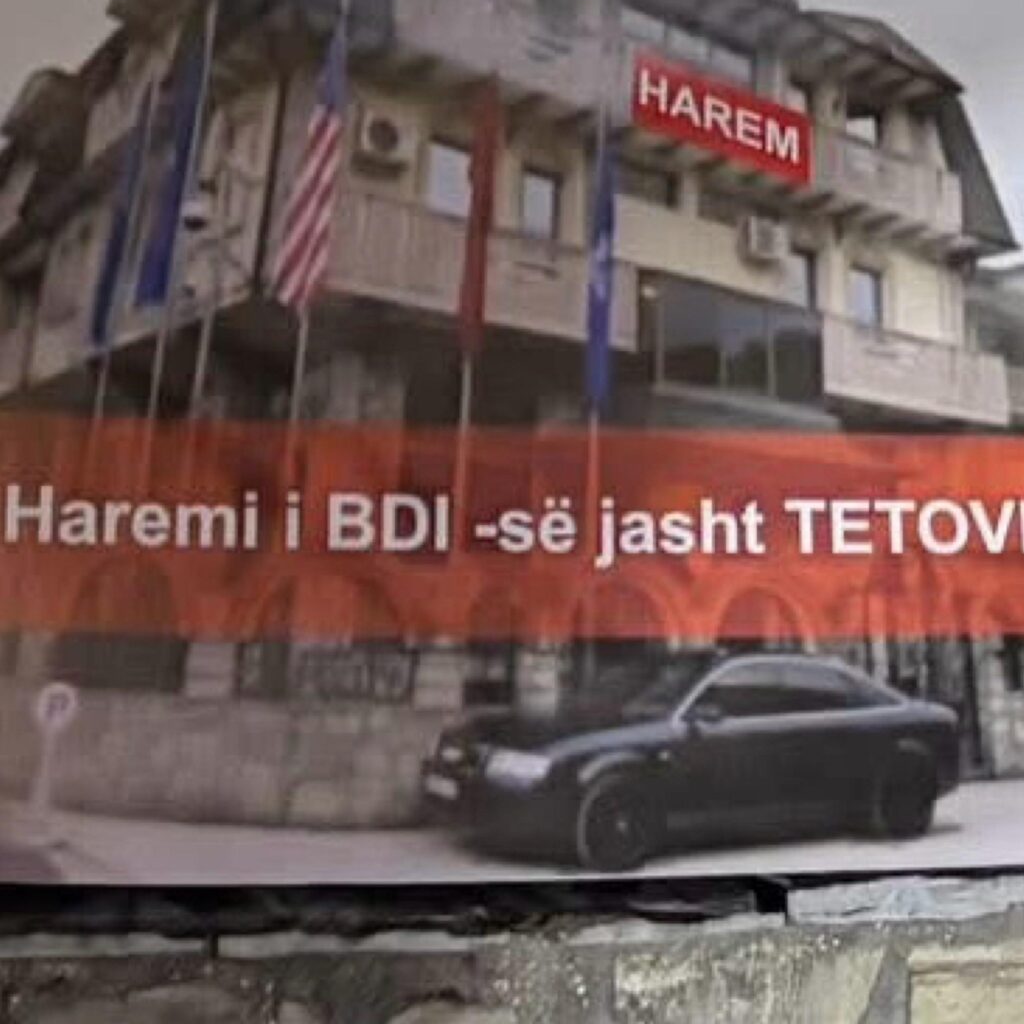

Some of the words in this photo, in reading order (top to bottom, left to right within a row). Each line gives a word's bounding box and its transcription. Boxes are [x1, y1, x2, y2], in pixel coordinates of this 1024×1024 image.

[638, 69, 801, 164] HAREM
[4, 484, 258, 548] Haremi
[286, 491, 301, 549] i
[328, 493, 449, 551] BDI
[475, 497, 577, 553] -së
[594, 498, 765, 570] jasht
